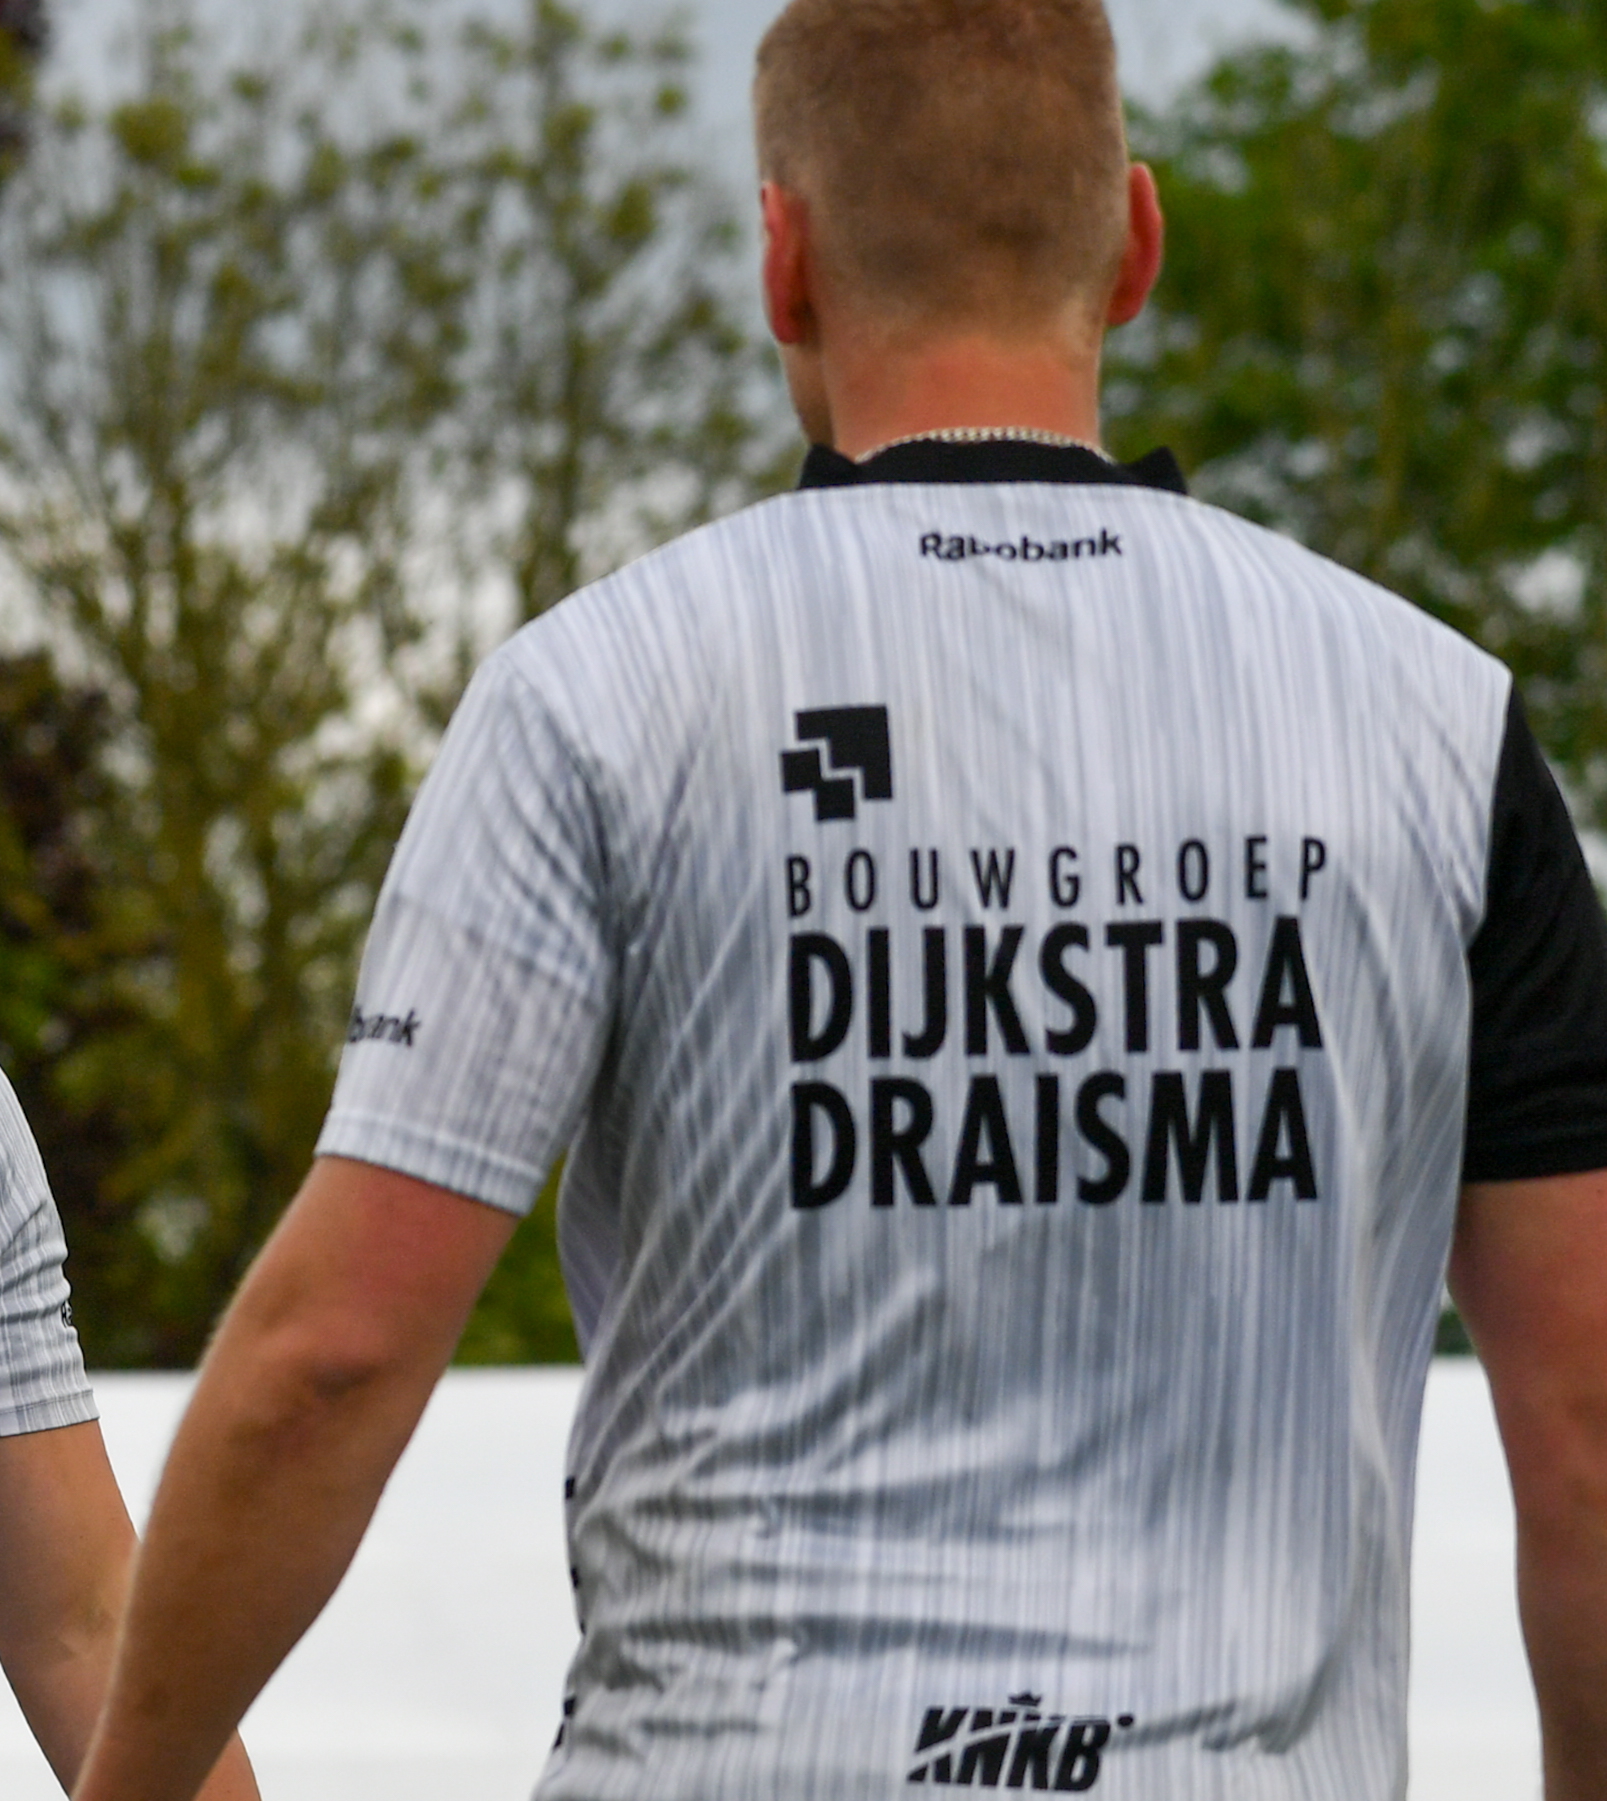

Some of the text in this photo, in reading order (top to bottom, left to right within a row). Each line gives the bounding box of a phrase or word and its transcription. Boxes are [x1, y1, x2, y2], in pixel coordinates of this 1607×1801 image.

[919, 527, 1123, 563] Rabobank
[786, 835, 1328, 919] BOUWGROEP
[788, 915, 1324, 1064] DIJKSTRA
[790, 1065, 1319, 1210] DRAISMA
[906, 1706, 1112, 1793] KNKB
